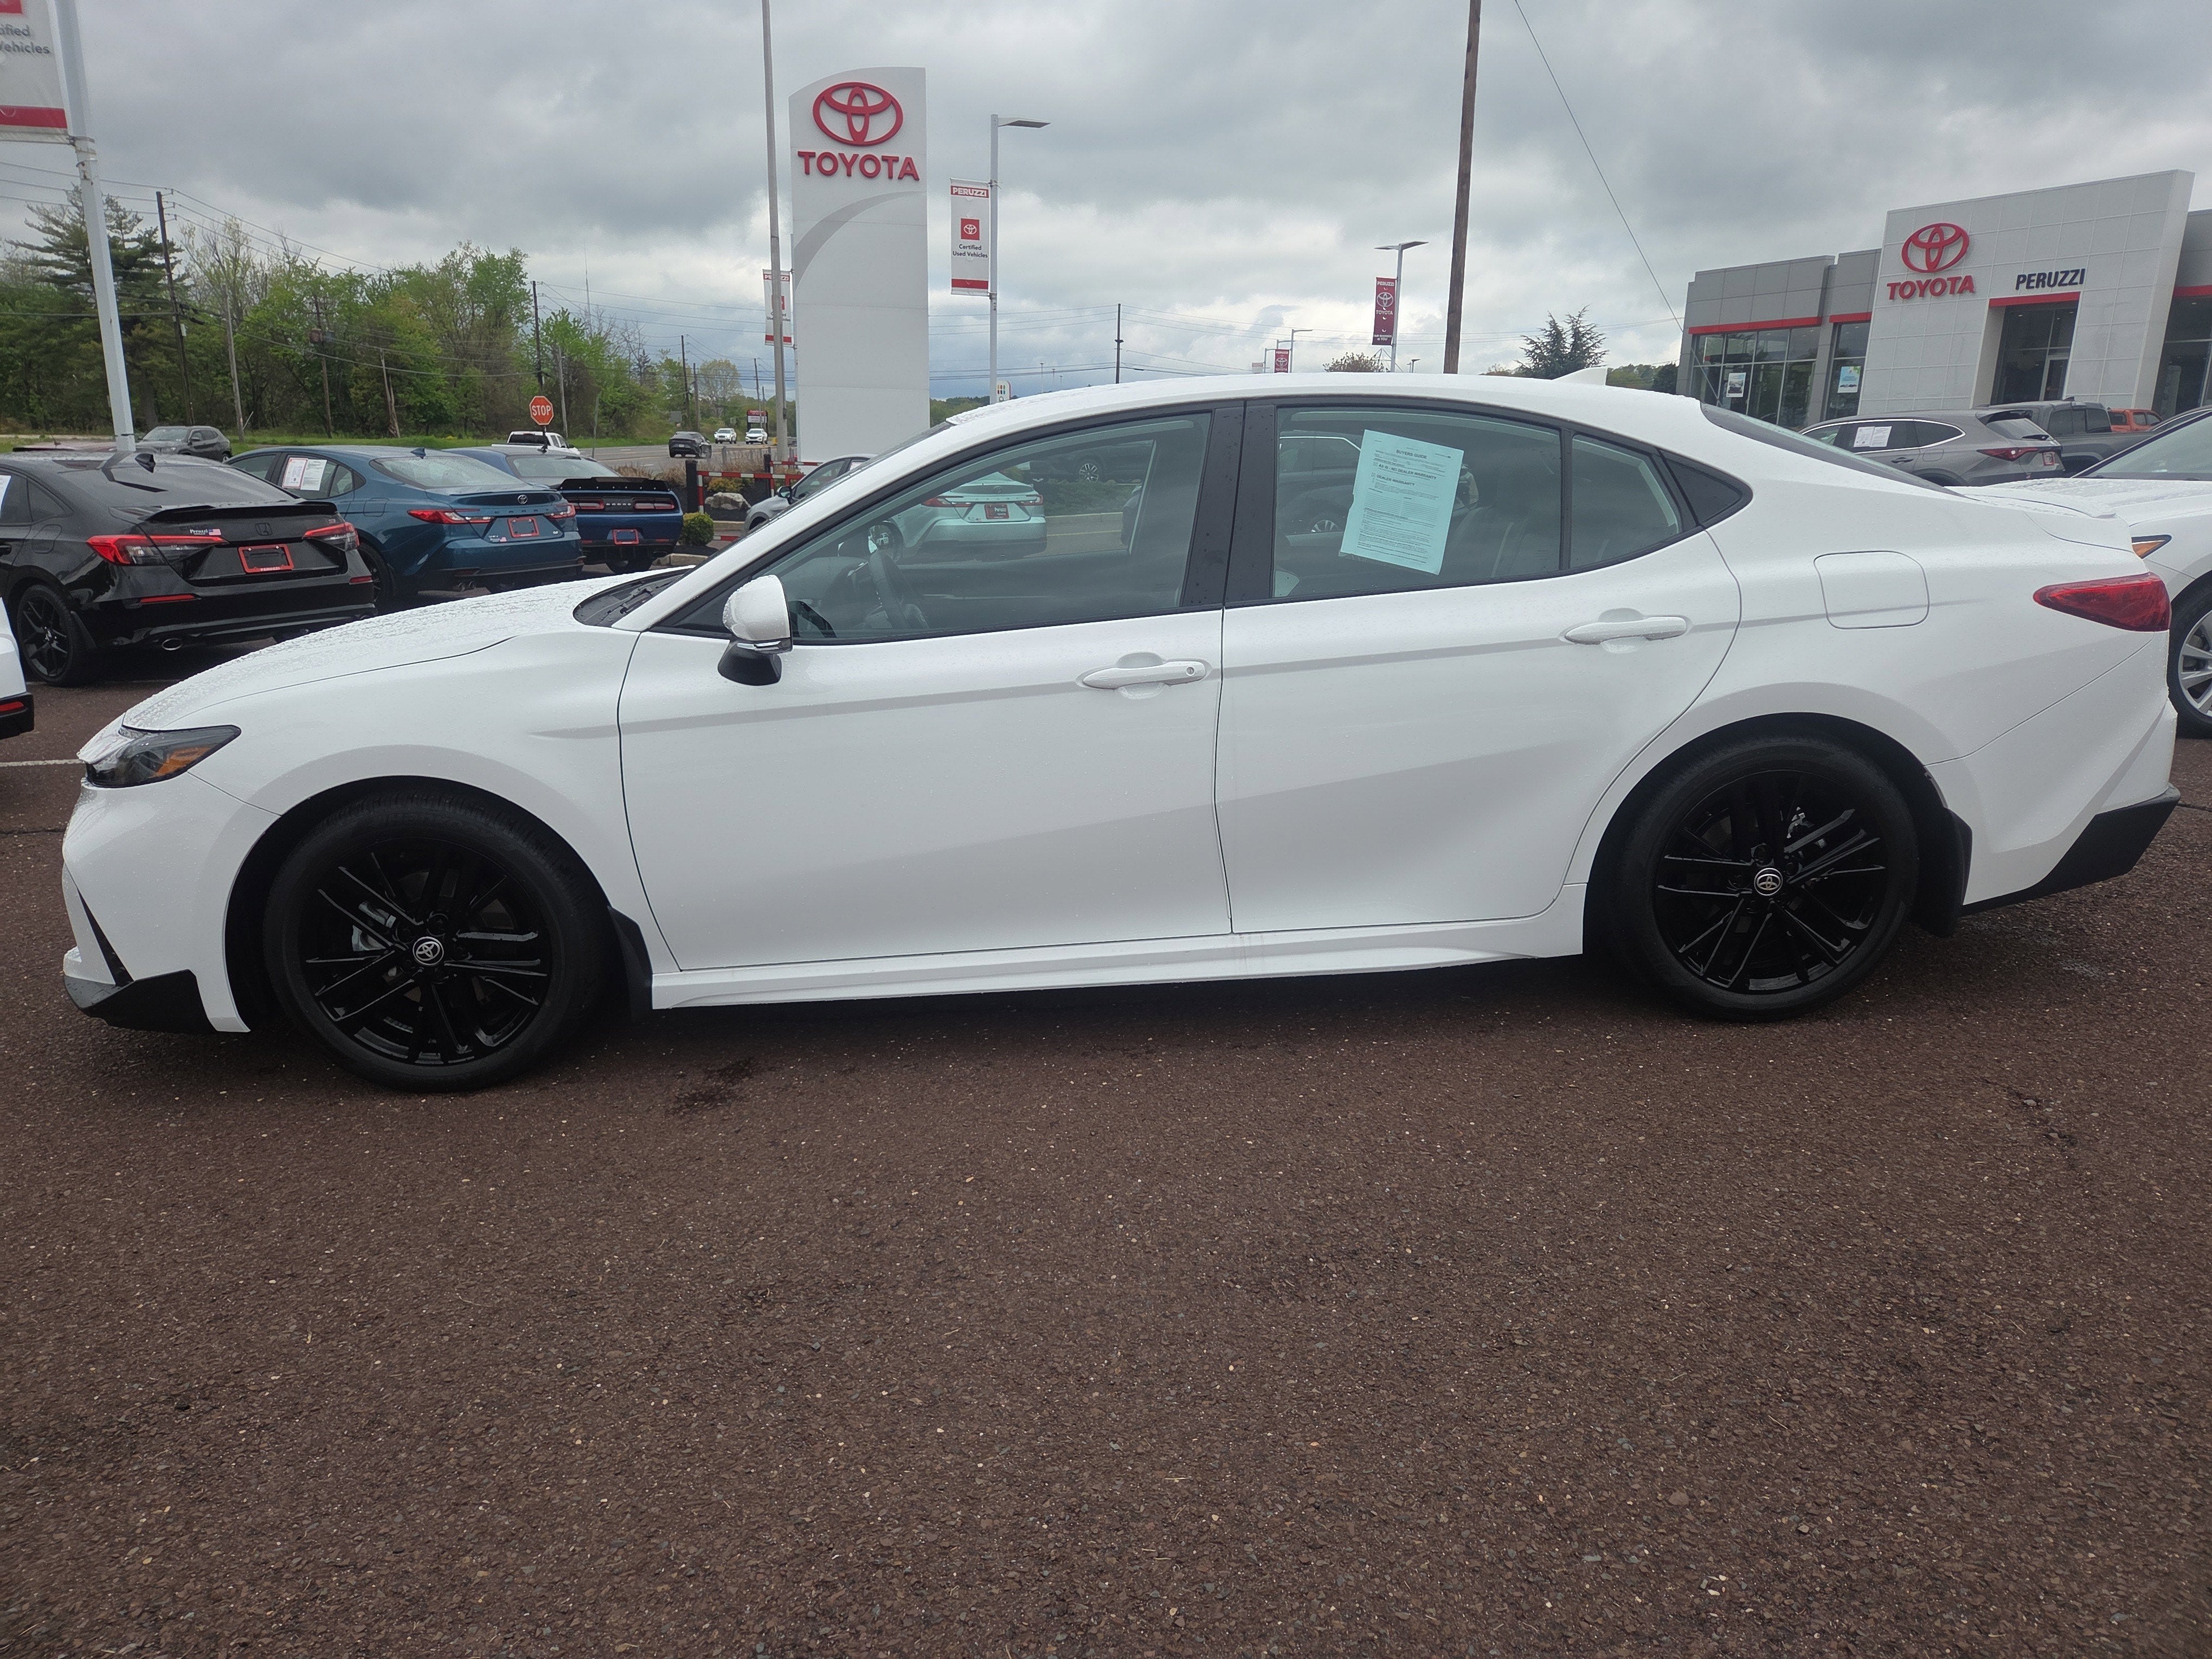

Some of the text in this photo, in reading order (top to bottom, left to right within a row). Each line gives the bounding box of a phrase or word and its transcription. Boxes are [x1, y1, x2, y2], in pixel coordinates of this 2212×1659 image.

[0, 23, 30, 36] ified
[798, 151, 920, 181] TOYOTA
[953, 187, 987, 197] PERUZZI
[1887, 275, 1976, 300] TOYOTA
[2016, 268, 2086, 290] PERUZZI
[531, 405, 551, 416] STOP
